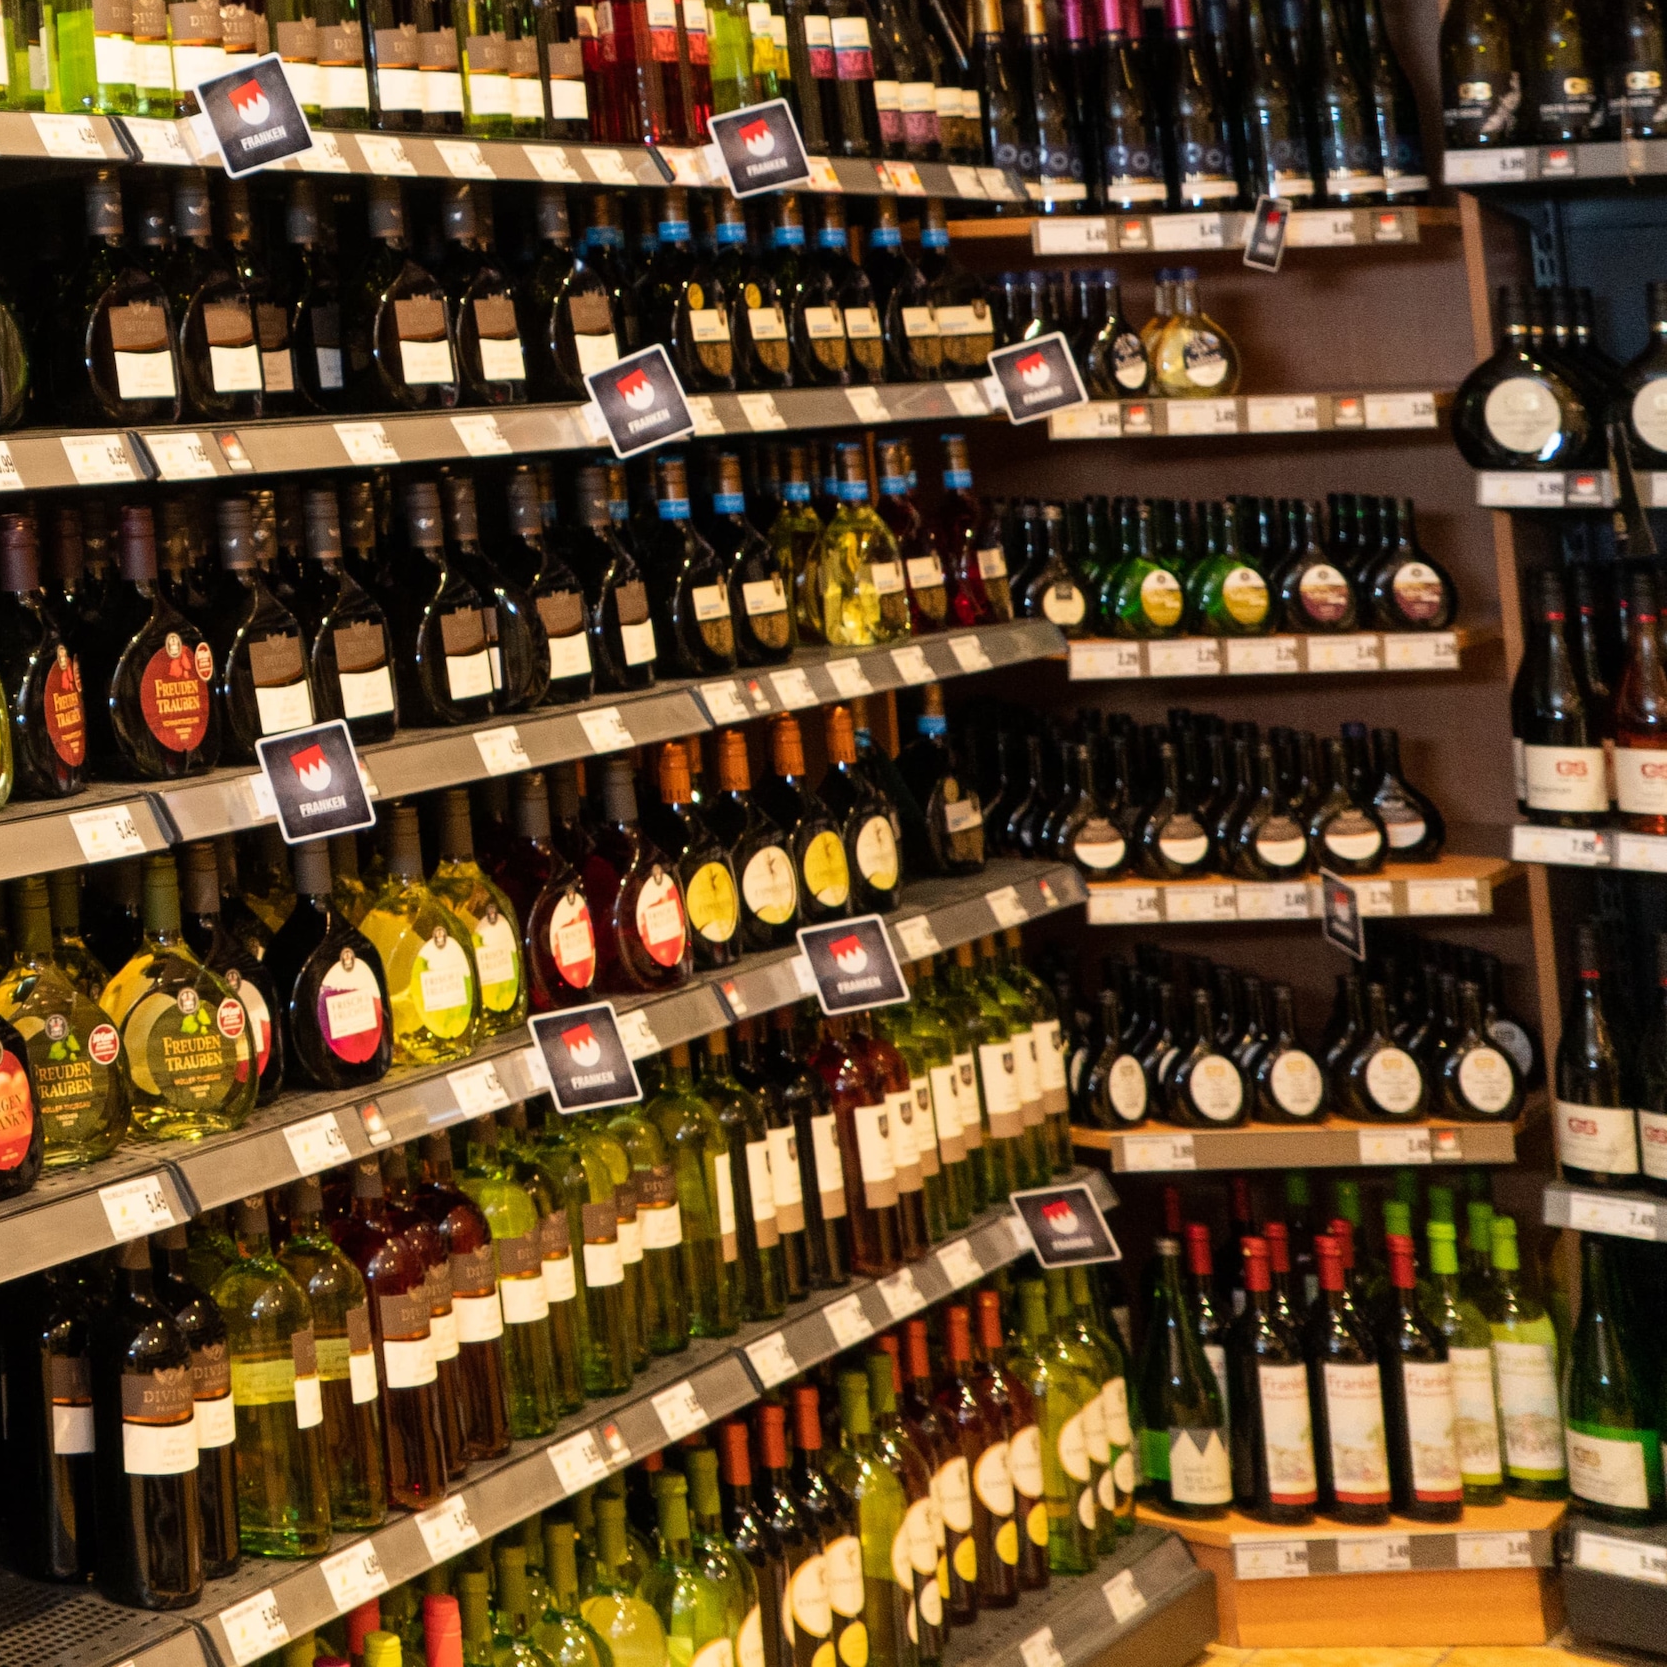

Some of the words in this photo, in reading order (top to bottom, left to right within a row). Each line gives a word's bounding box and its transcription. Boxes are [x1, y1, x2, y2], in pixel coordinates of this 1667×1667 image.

[78, 128, 96, 145] 4.99
[240, 127, 287, 150] FRANKEN
[746, 157, 788, 175] FRANKEN
[629, 413, 669, 432] FRANKEN
[155, 680, 200, 697] FREUDEN
[156, 696, 200, 712] TRAUBEN
[300, 793, 346, 816] FRANKEN
[835, 973, 881, 993] FRANKEN
[163, 1035, 221, 1055] FREUDEN
[165, 1051, 223, 1071] TRAUBEN
[570, 1069, 616, 1089] FRANKEN
[147, 1192, 165, 1212] 5.49
